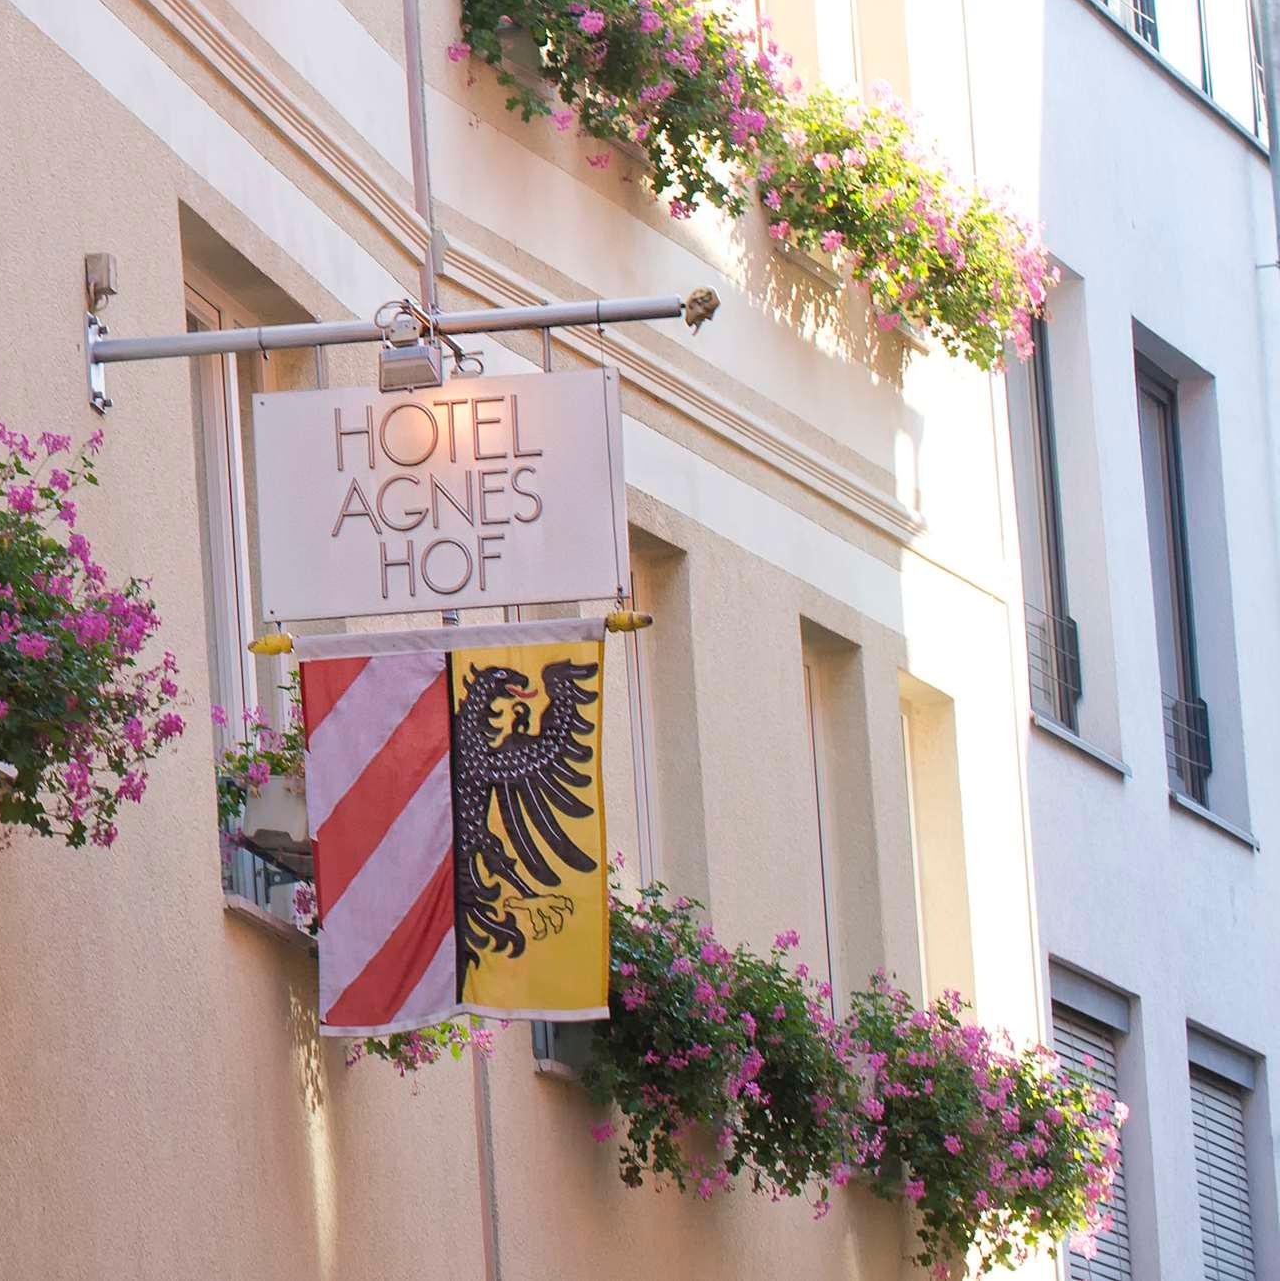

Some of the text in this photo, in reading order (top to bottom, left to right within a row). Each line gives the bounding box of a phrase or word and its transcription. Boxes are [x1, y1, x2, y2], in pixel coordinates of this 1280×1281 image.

[334, 394, 543, 471] HOTEL
[331, 464, 543, 537] AGNES
[379, 533, 505, 599] HOF
